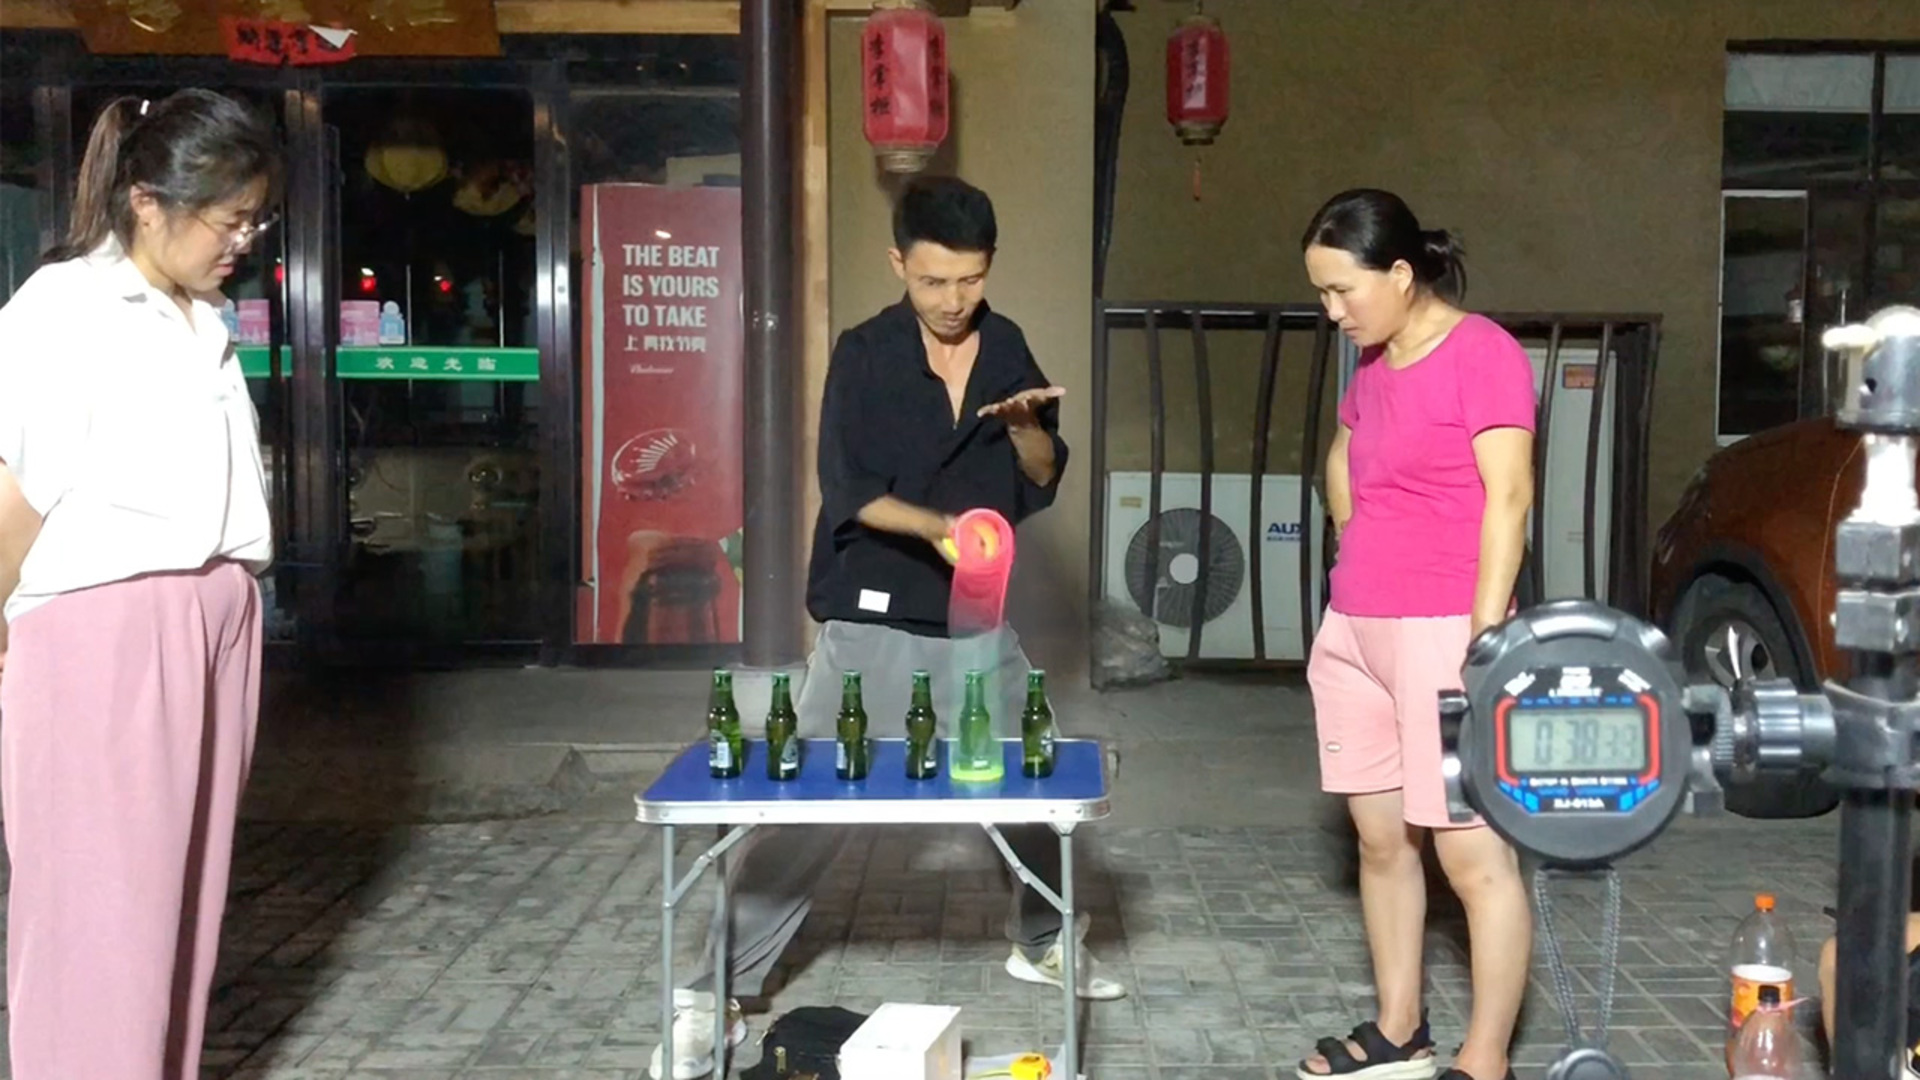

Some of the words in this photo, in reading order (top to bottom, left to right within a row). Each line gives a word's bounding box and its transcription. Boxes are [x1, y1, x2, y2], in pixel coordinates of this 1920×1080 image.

[622, 244, 662, 266] THE
[668, 246, 720, 267] BEAT
[622, 275, 643, 296] IS
[649, 275, 719, 298] YOURS
[622, 304, 649, 326] TO
[654, 305, 707, 327] TAKE
